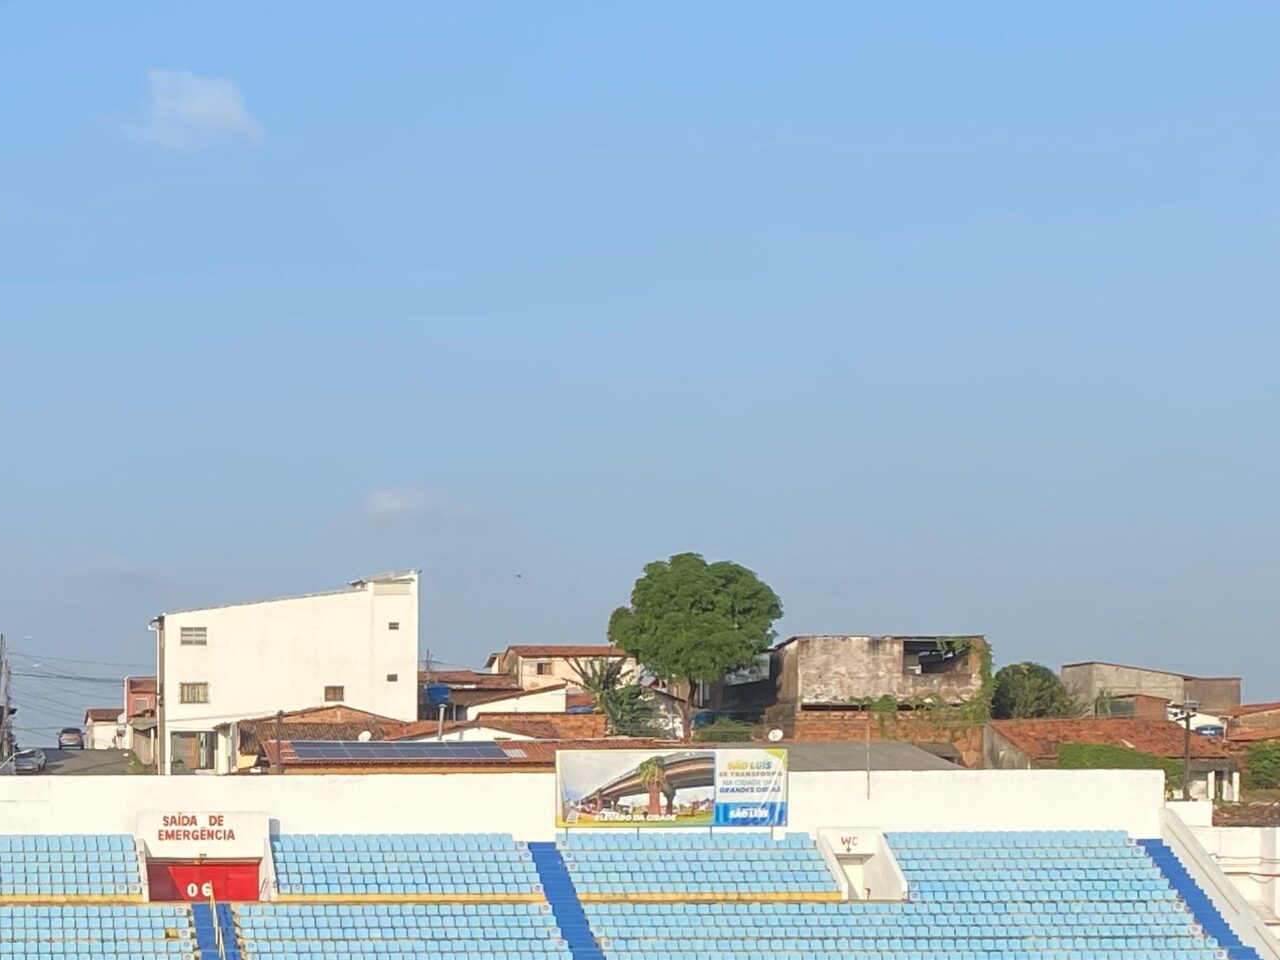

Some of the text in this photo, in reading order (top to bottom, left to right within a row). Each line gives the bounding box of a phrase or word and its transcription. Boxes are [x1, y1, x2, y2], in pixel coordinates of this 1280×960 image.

[162, 812, 224, 826] SAÍDA DE
[158, 826, 236, 840] EMERGÊNCIA
[841, 836, 858, 846] WC
